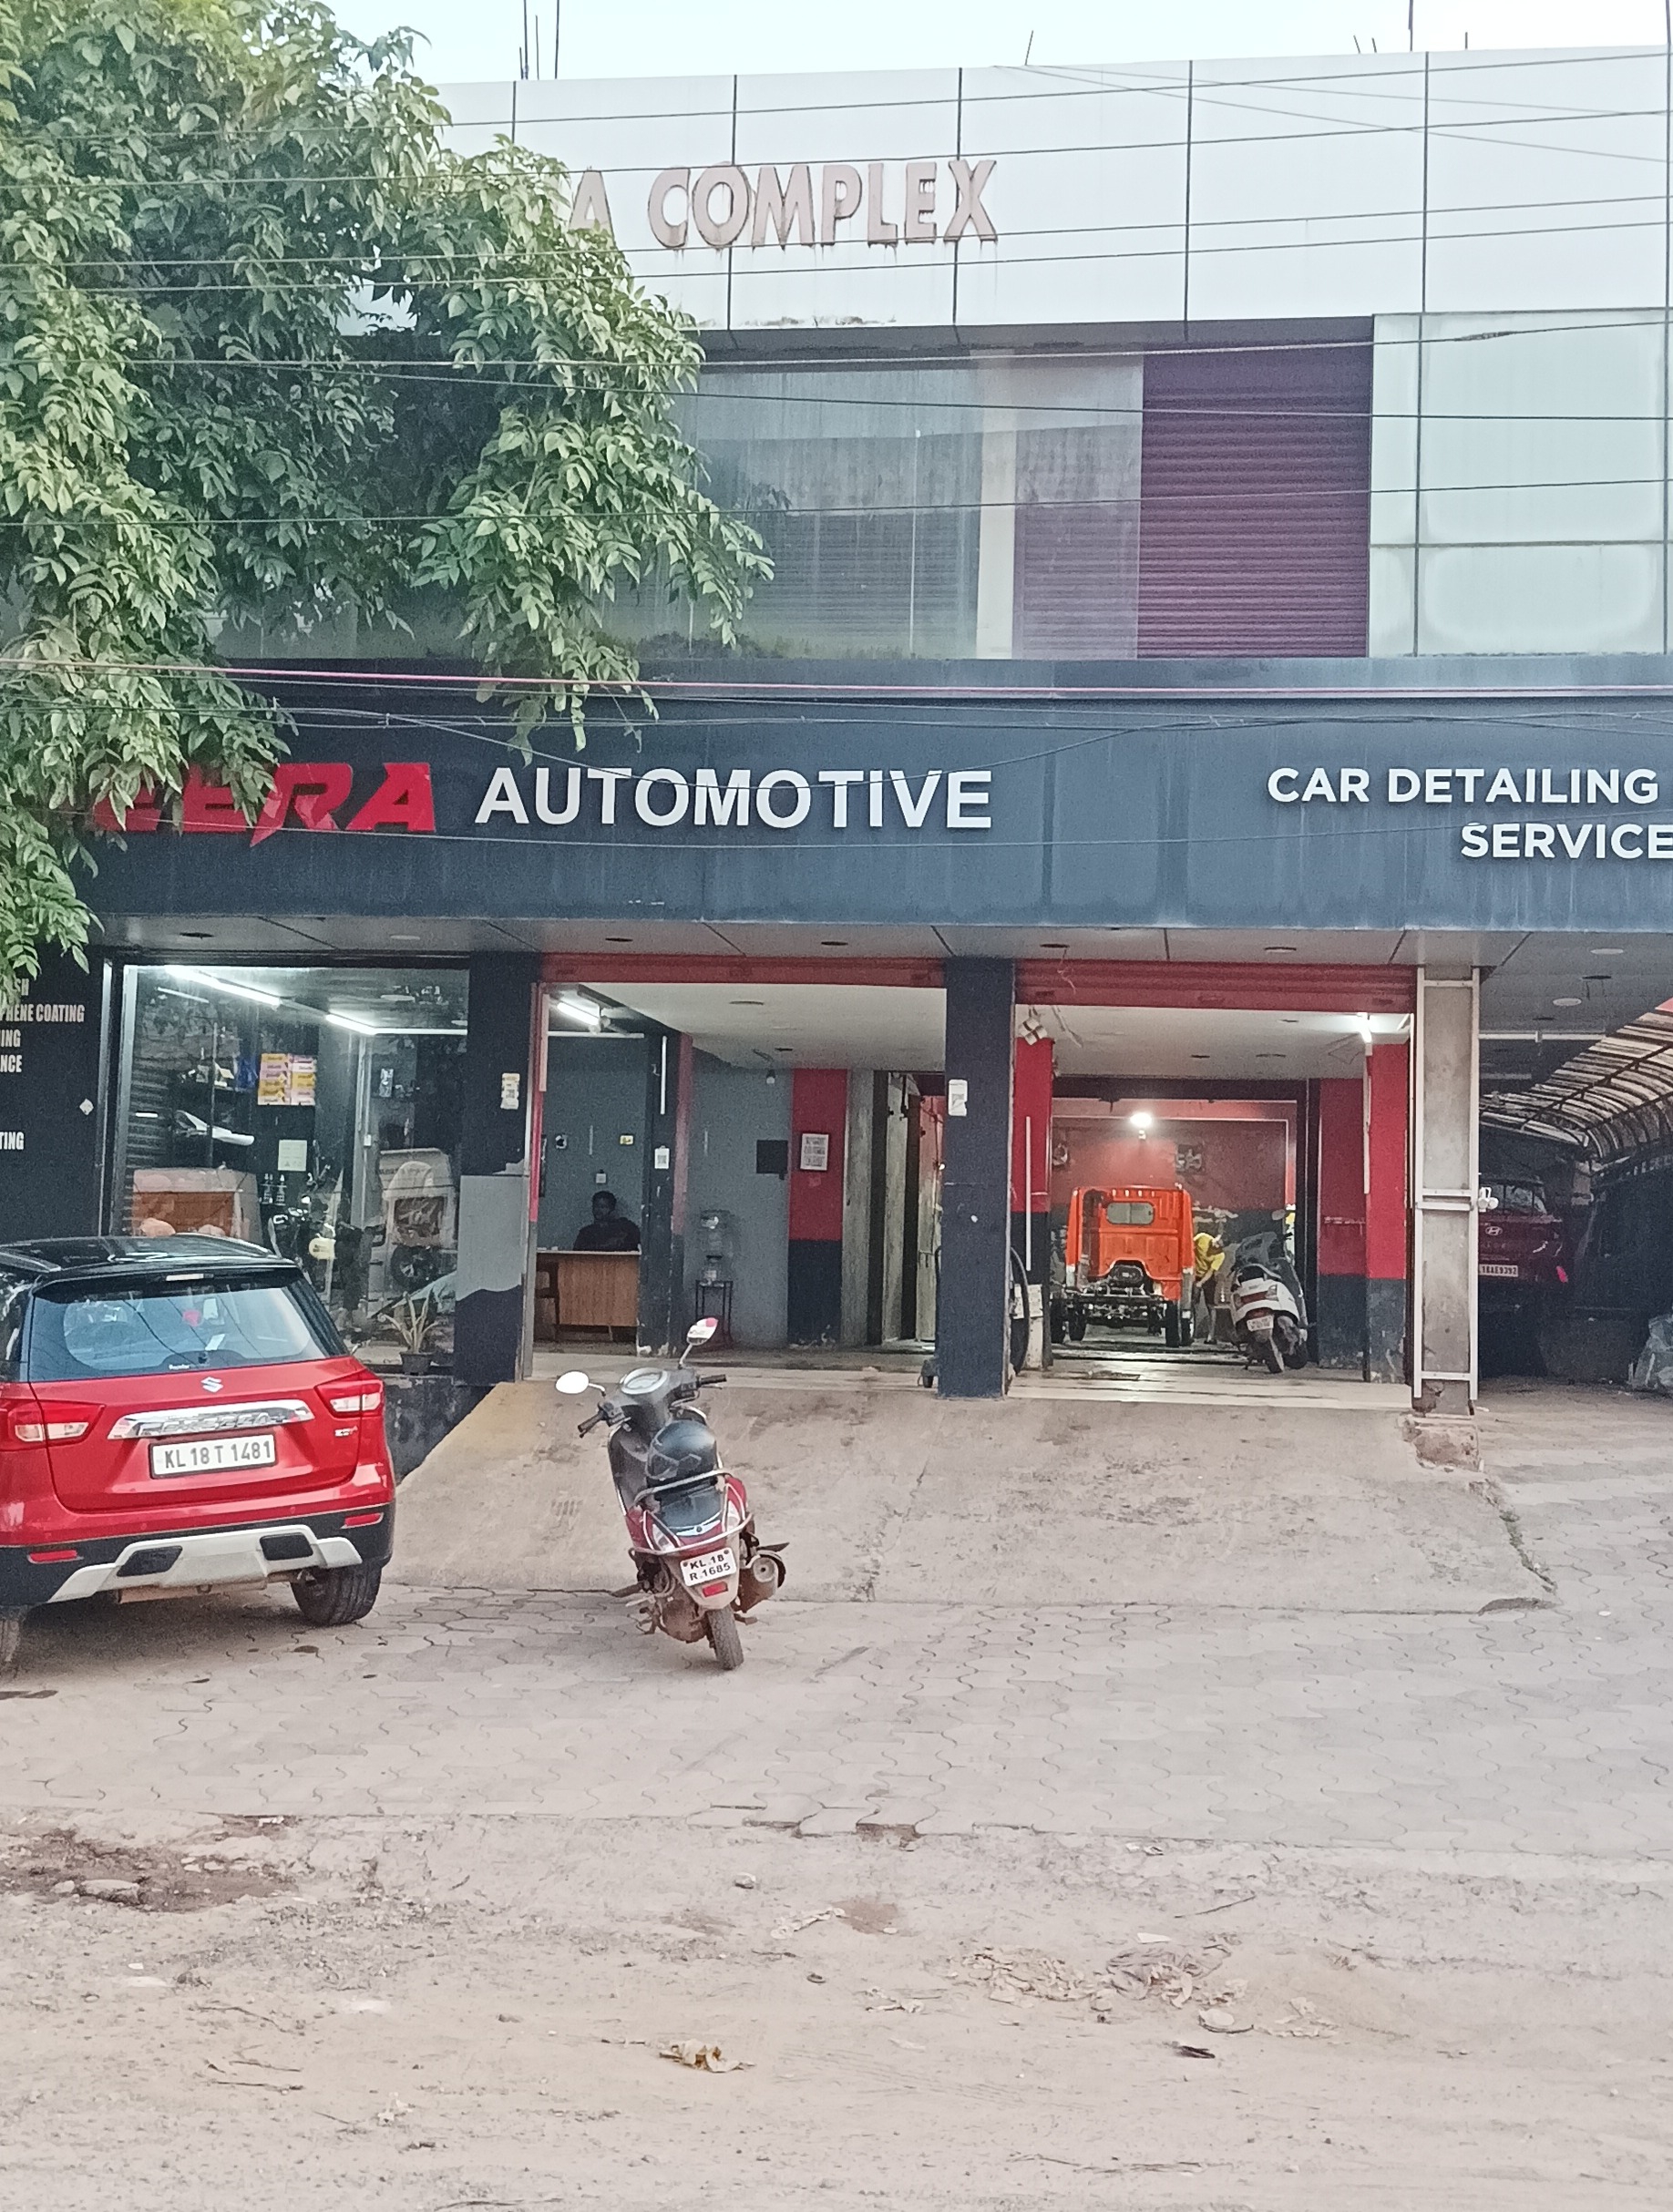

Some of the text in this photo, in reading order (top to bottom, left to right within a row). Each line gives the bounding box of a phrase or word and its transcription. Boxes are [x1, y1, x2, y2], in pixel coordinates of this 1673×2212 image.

[648, 159, 999, 250] COMPLEX
[475, 767, 993, 829] AUTOMOTIVE
[1268, 767, 1659, 804] CAR DETAILING
[36, 1003, 86, 1023] COATING
[165, 1440, 272, 1469] KL 18 T 1481
